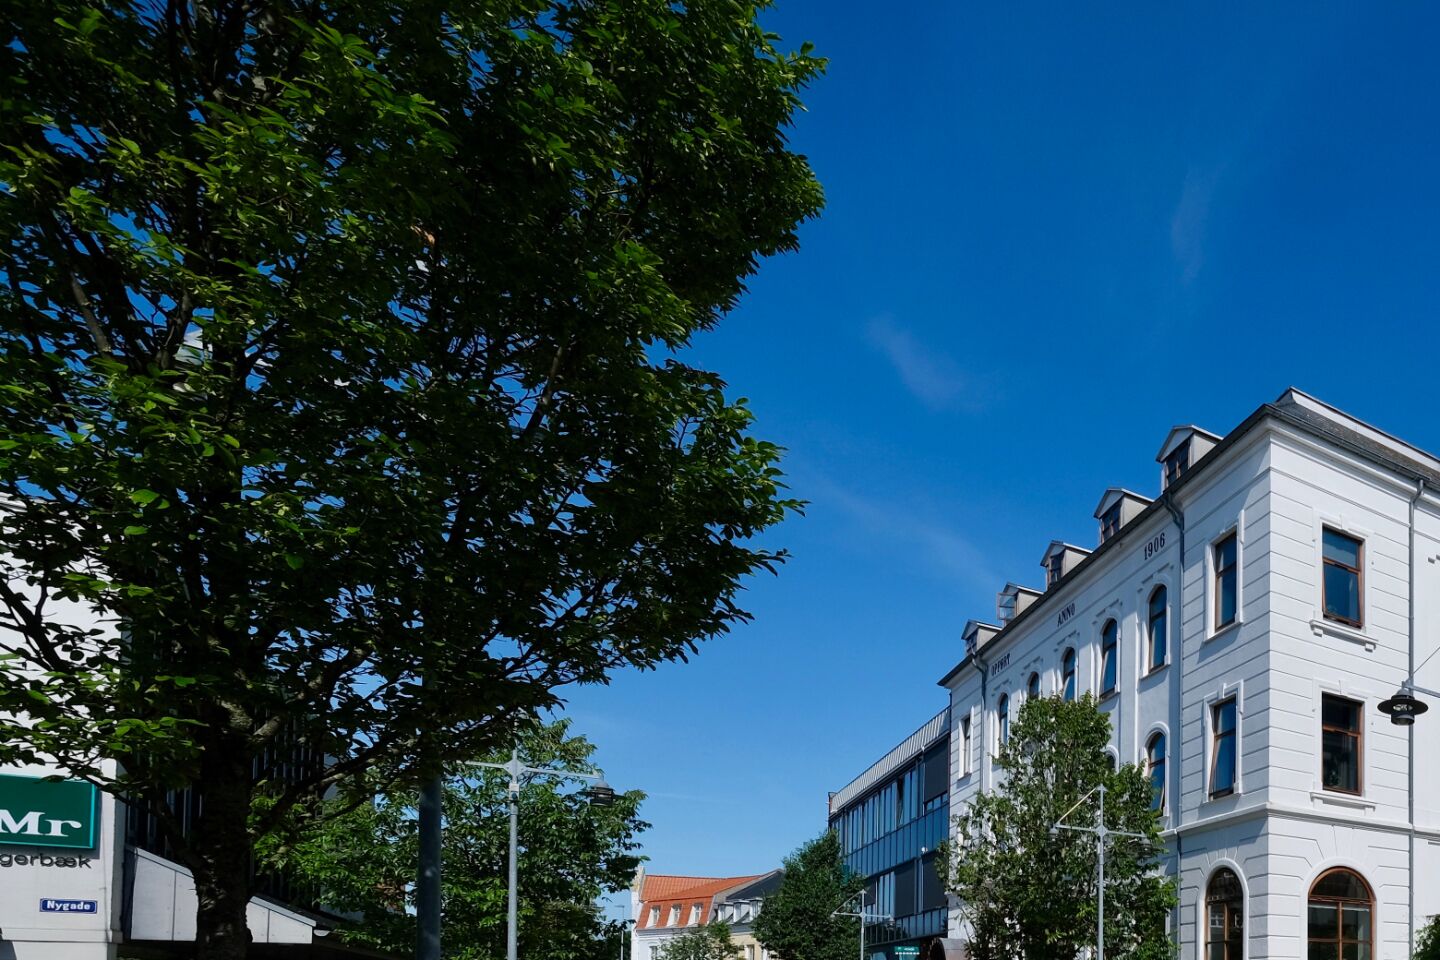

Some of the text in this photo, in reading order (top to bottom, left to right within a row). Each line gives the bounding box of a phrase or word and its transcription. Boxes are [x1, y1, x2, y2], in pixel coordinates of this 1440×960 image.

[1057, 603, 1076, 627] ANNO
[1144, 532, 1165, 560] 1906
[47, 900, 91, 911] Nygade
